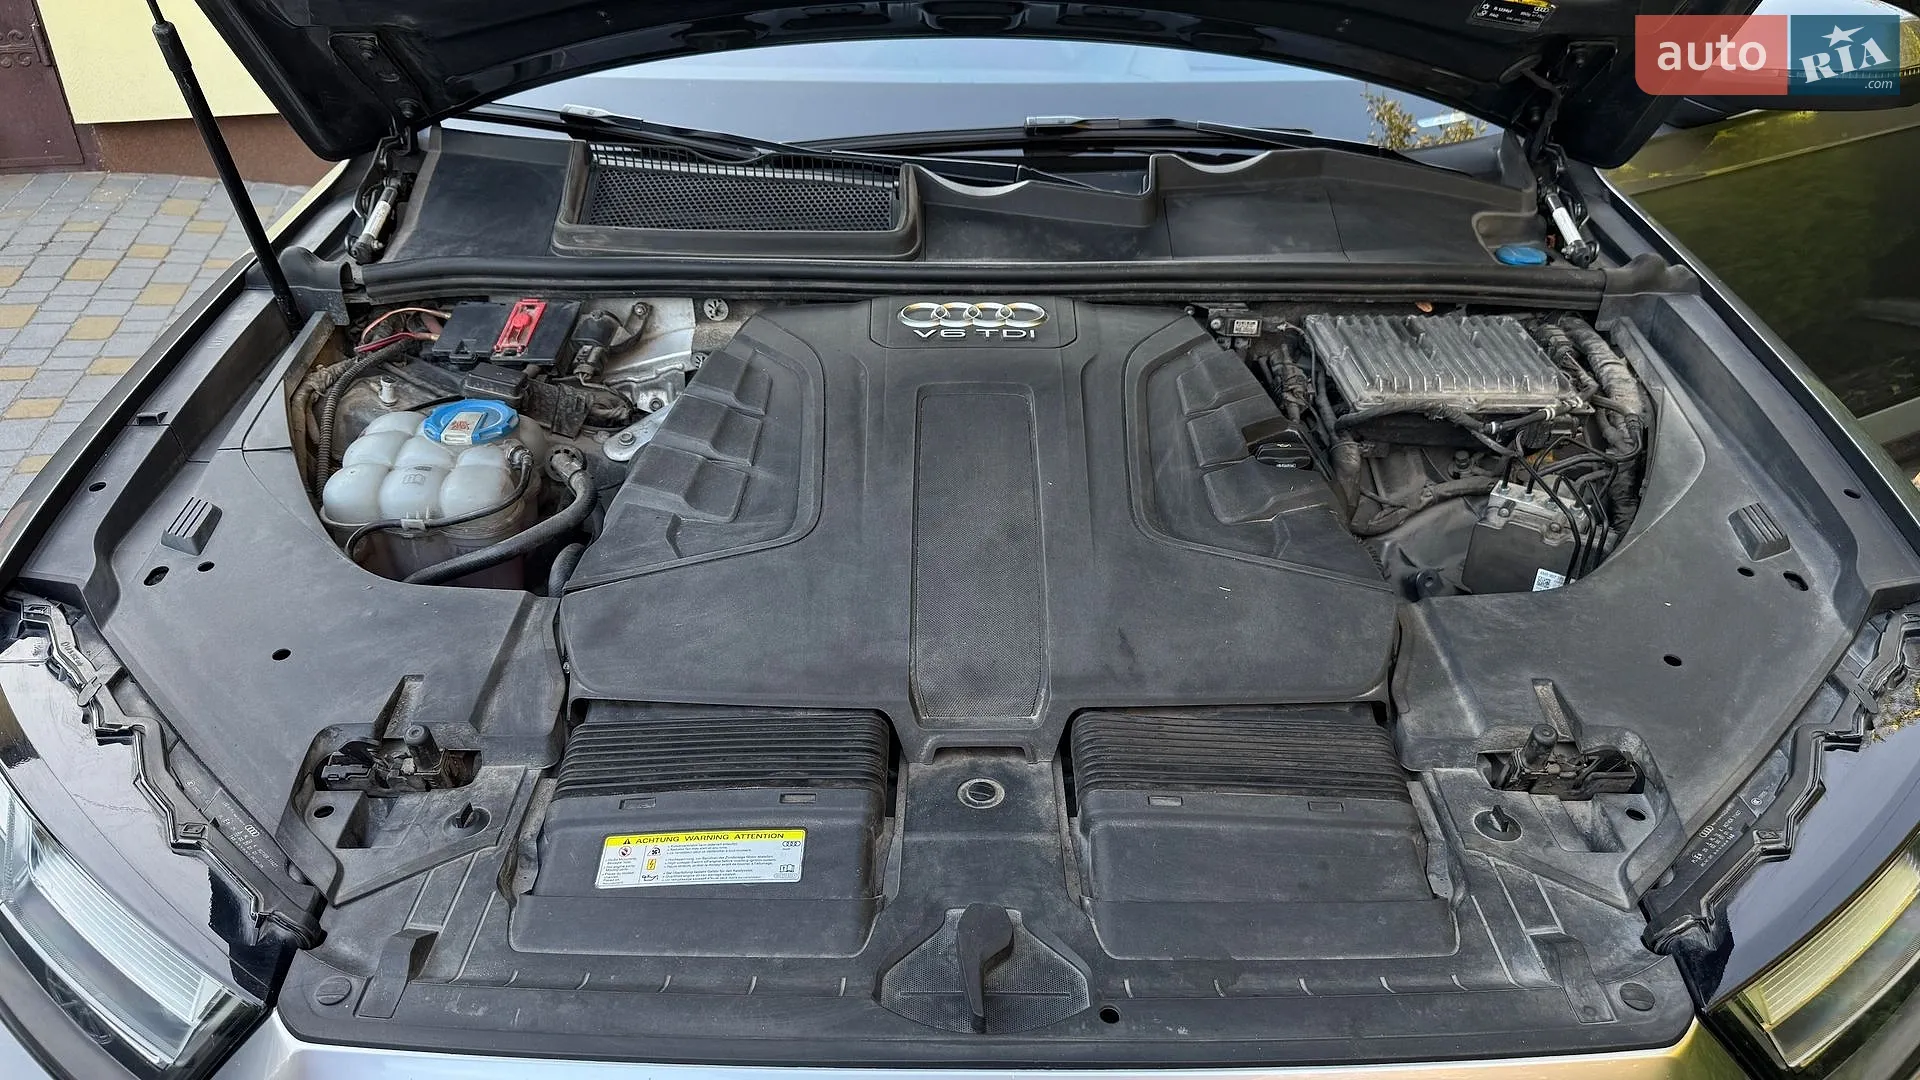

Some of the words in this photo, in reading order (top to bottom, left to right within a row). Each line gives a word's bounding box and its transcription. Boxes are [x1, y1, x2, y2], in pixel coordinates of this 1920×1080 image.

[913, 329, 966, 338] V6
[976, 329, 1036, 338] TDI
[636, 836, 680, 844] ACHTUNG
